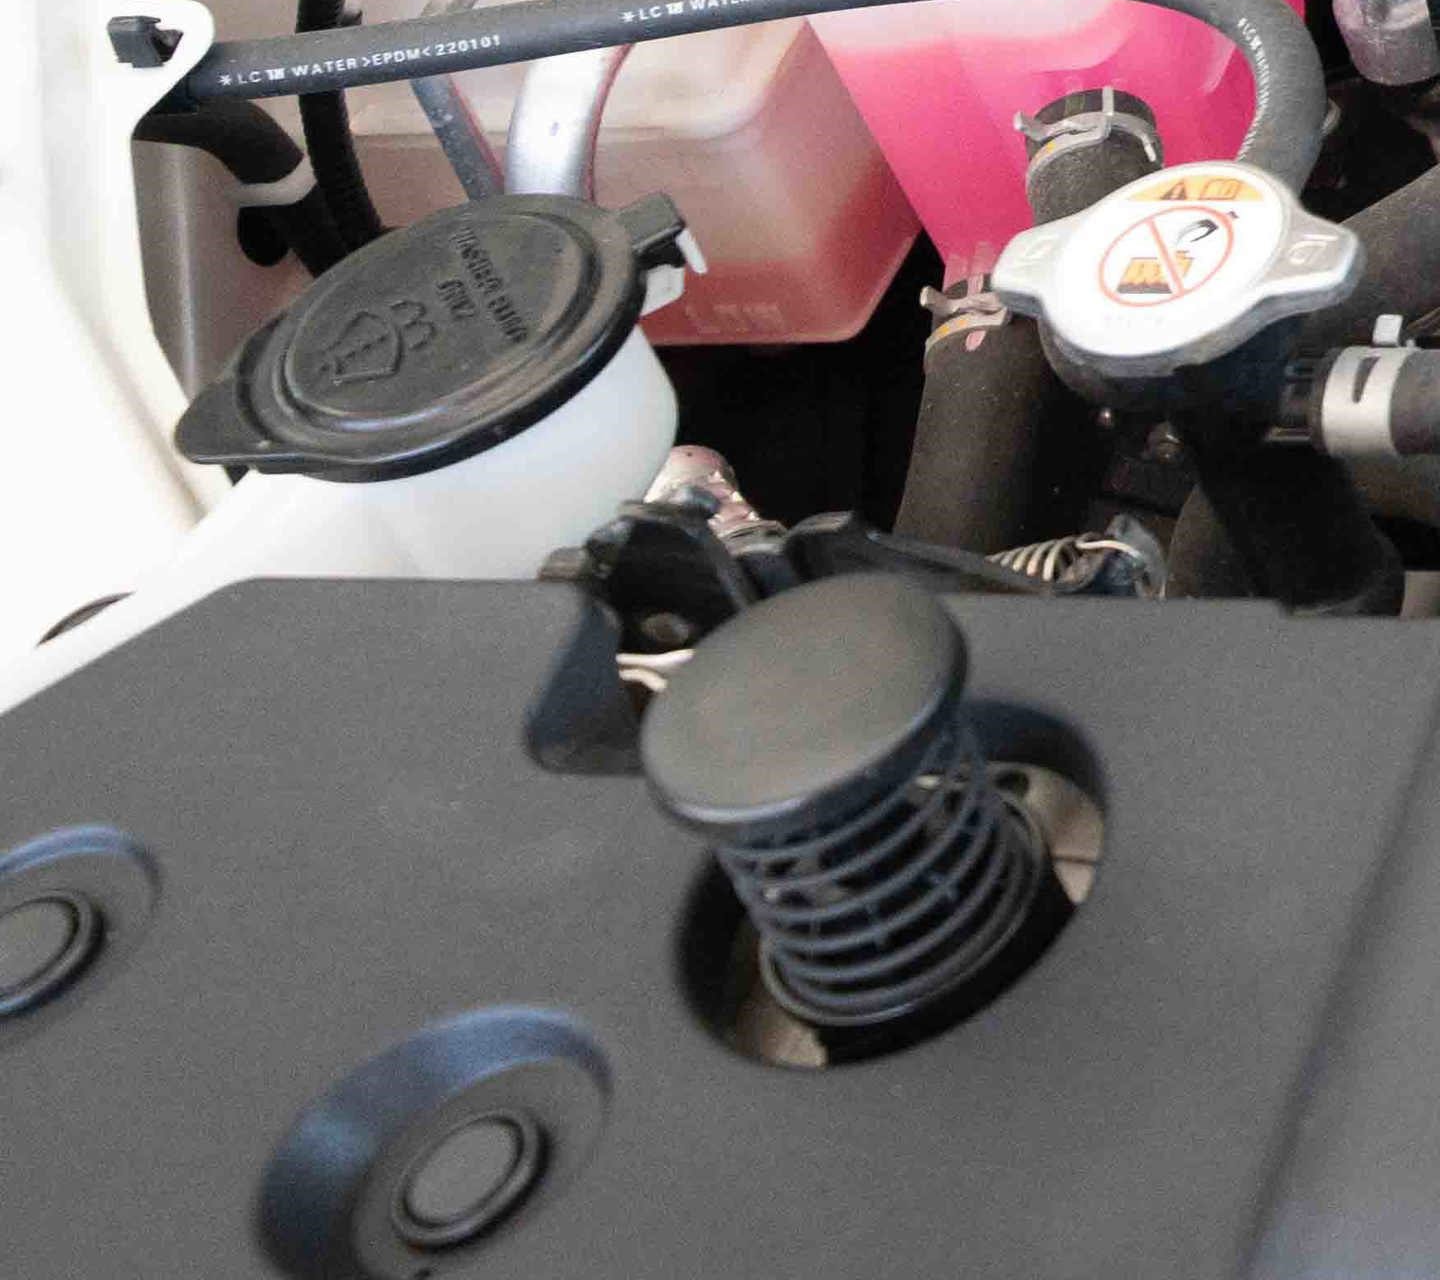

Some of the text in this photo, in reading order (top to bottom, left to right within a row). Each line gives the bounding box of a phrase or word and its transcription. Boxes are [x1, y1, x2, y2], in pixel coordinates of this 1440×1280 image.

[638, 3, 662, 21] LC
[238, 68, 262, 85] LC
[291, 57, 358, 77] WATER
[435, 34, 502, 58] 220101
